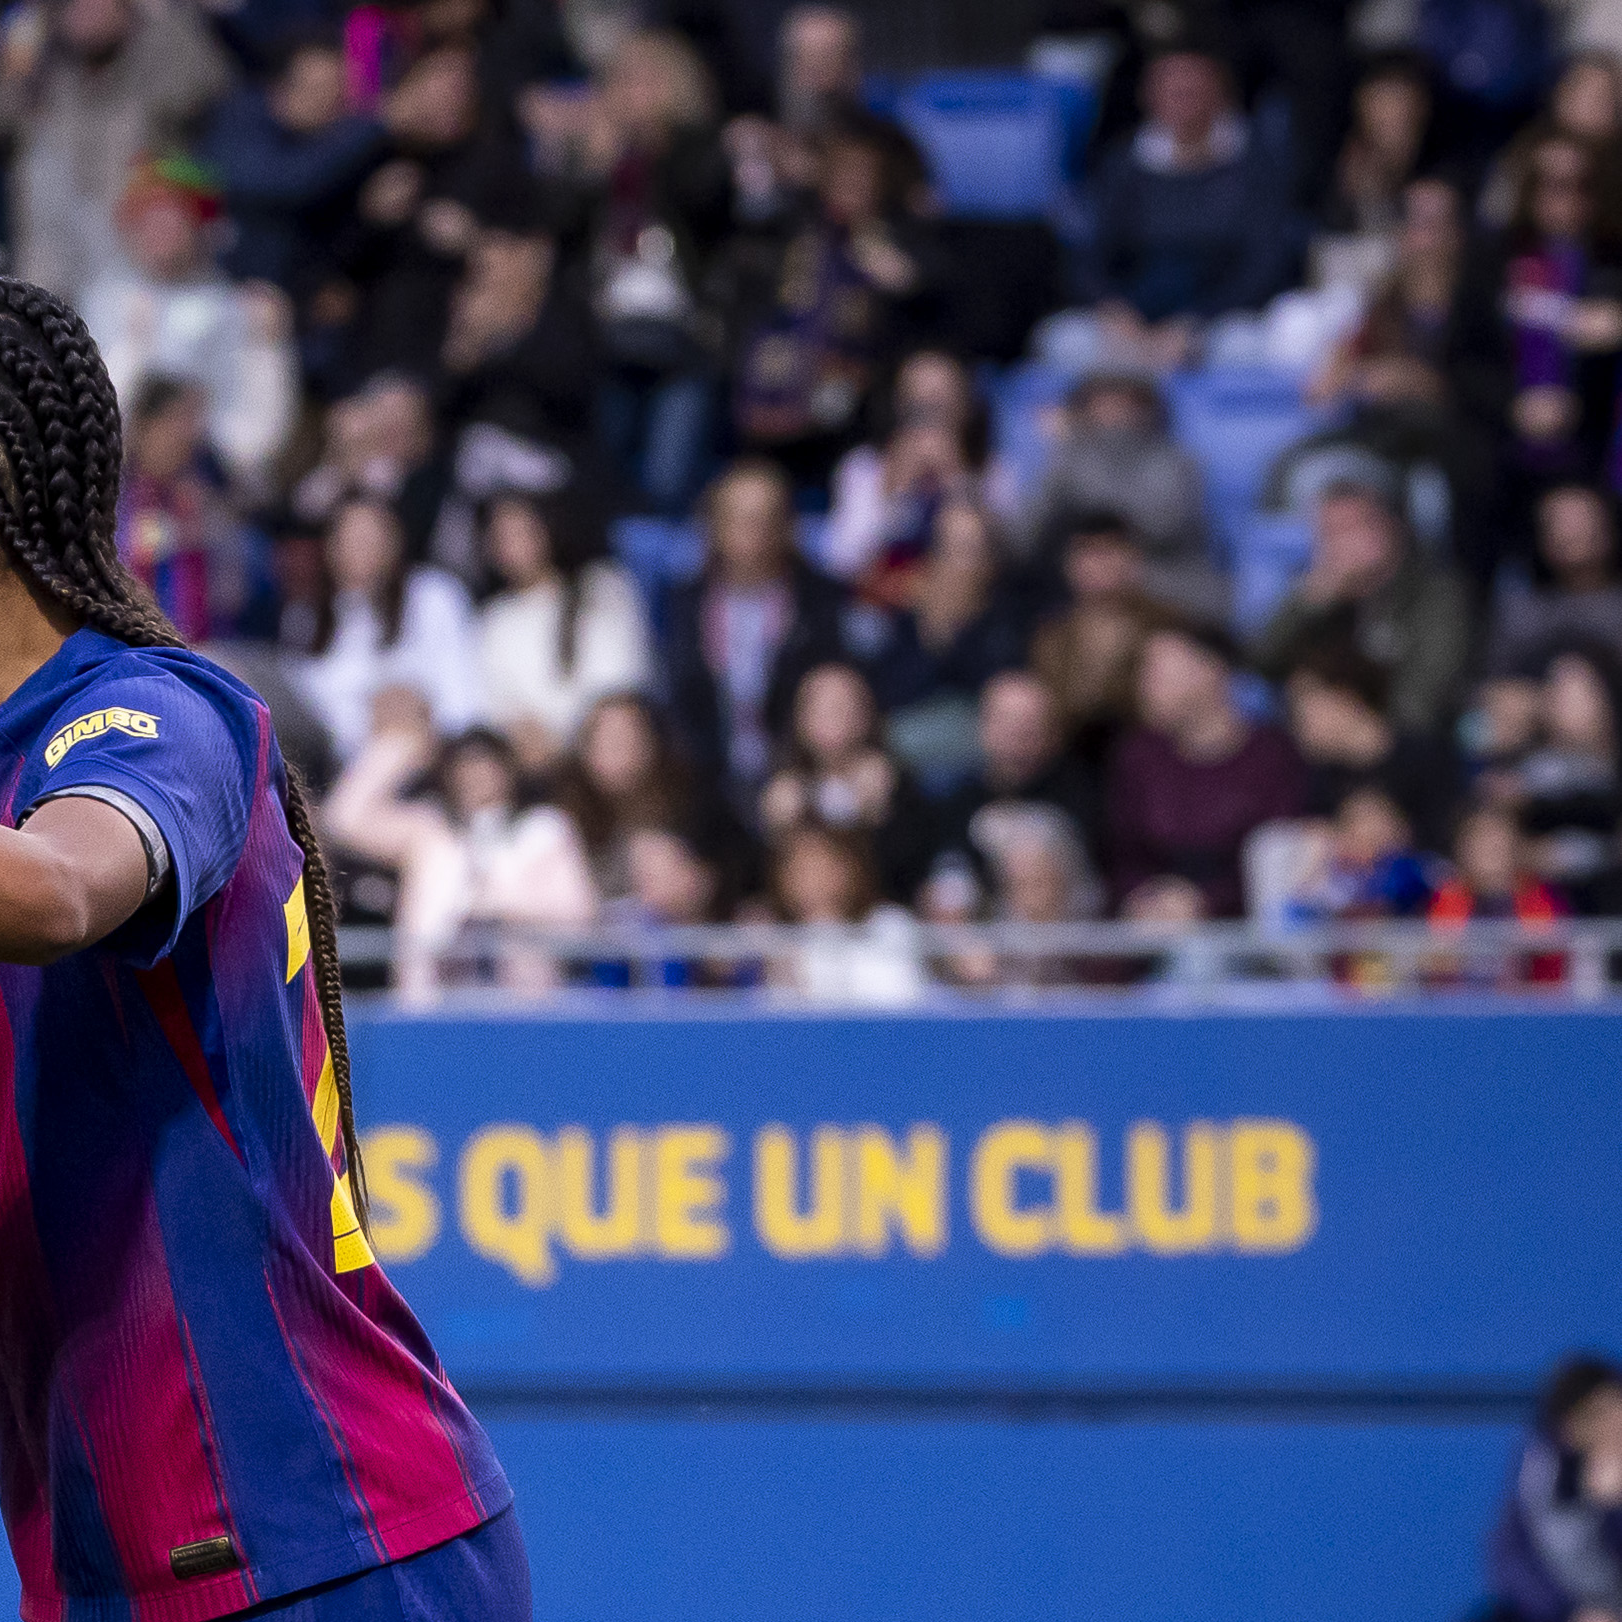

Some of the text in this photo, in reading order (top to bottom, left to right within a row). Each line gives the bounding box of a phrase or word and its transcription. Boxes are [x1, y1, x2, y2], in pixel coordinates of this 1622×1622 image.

[44, 709, 157, 768] BIMBO
[458, 1122, 730, 1287] QUE
[754, 1121, 949, 1259] UN
[970, 1119, 1318, 1257] CLUB
